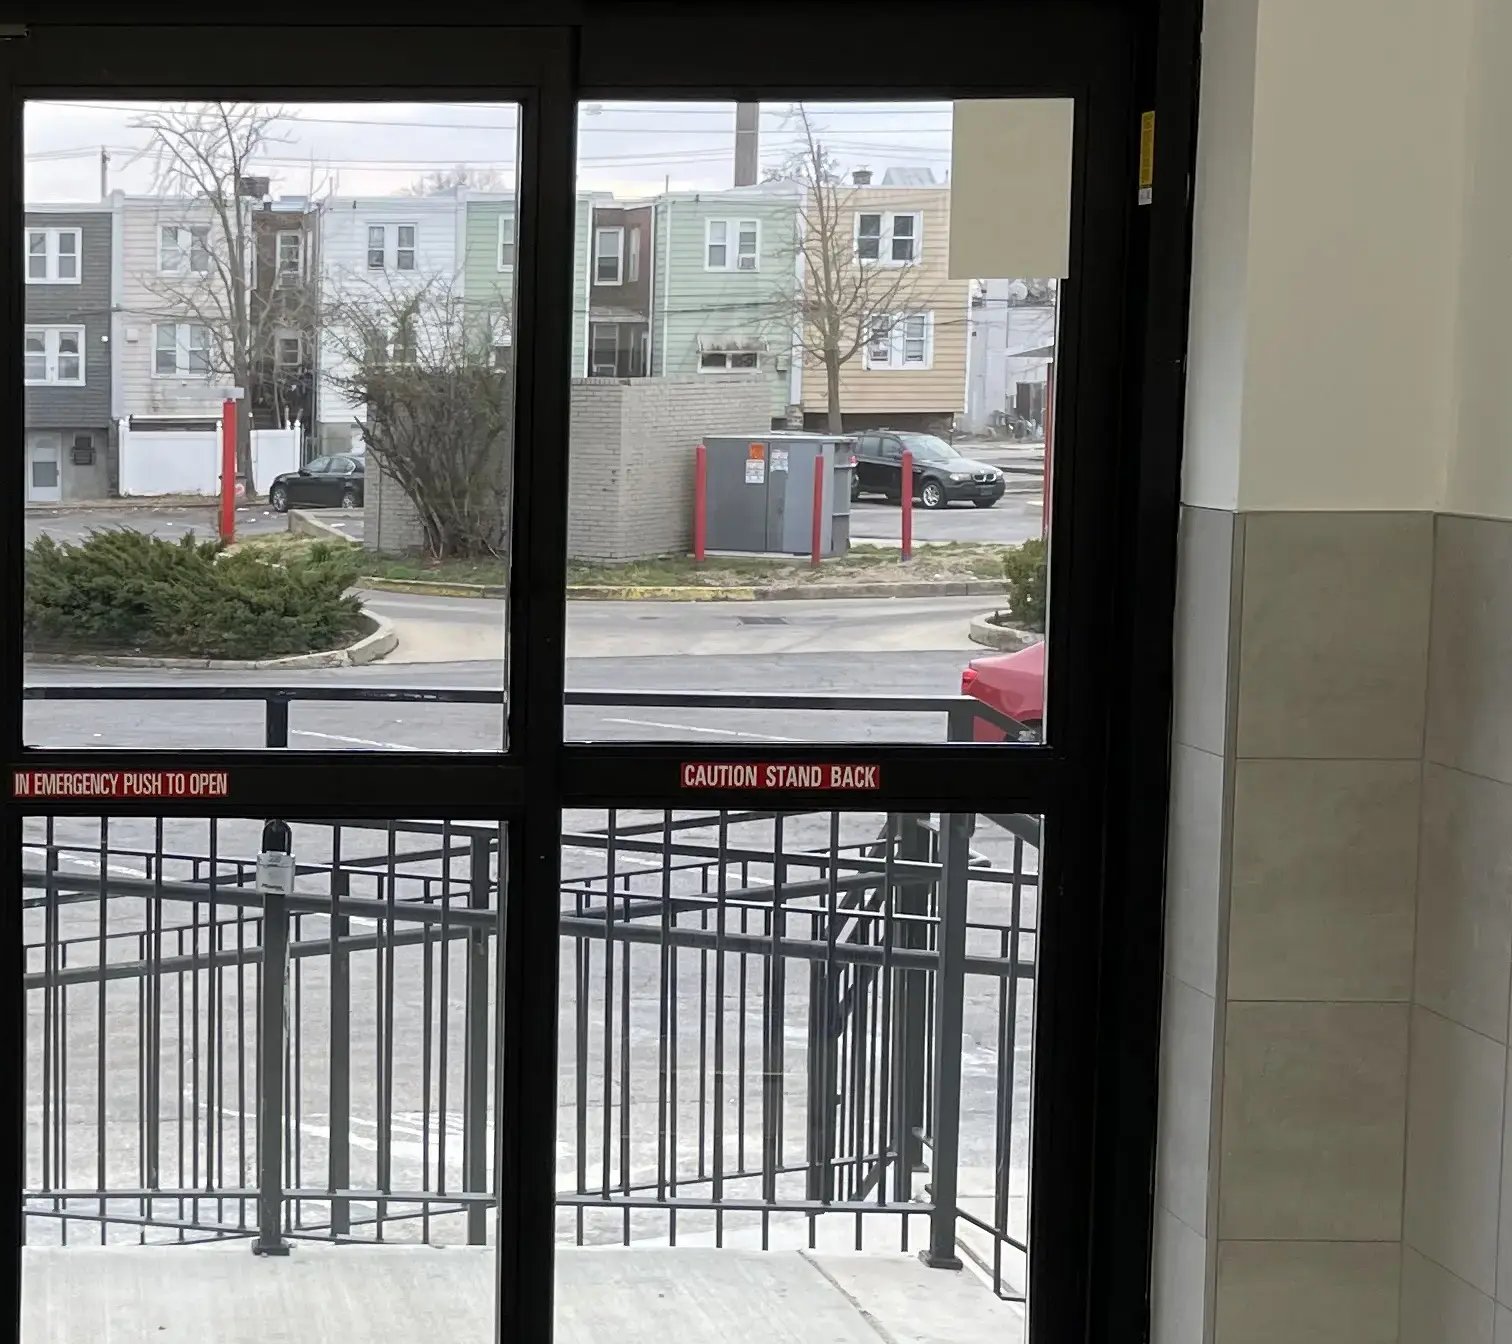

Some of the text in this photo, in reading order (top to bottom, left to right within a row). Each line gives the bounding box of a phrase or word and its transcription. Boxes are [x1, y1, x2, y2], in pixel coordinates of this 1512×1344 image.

[15, 773, 228, 795] IN EMERGENCY PUSH TO OPEN
[684, 764, 876, 787] CAUTION STAND BACK
